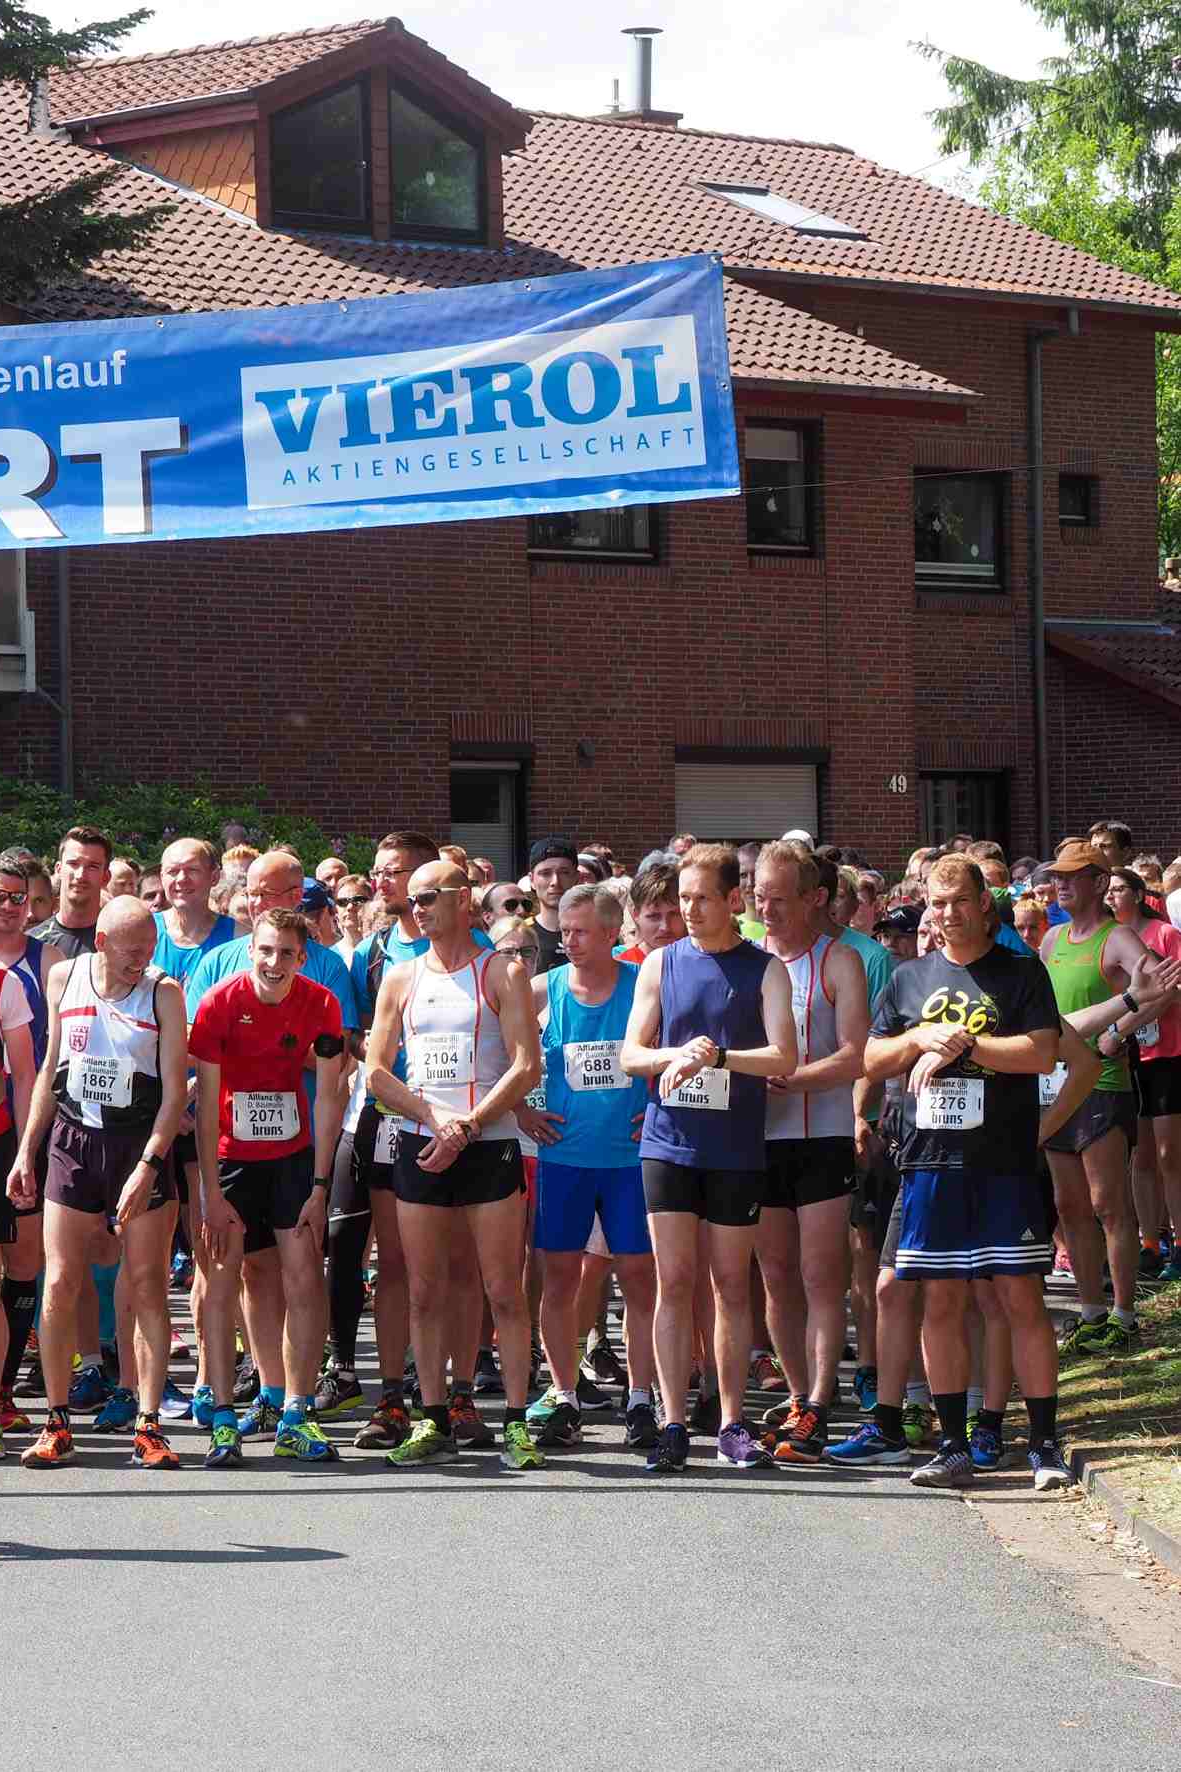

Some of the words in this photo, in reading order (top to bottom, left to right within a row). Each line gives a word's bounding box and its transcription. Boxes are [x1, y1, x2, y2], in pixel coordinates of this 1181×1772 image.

[255, 344, 693, 454] VIEROL
[282, 427, 695, 486] AKTIENGESELLSCHAFT
[889, 774, 908, 793] 49
[424, 1051, 459, 1065] 2104
[584, 1058, 612, 1072] 688
[426, 1066, 457, 1080] bruns
[582, 1073, 615, 1086] bruns
[82, 1073, 116, 1089] 1867
[82, 1086, 113, 1102] bruns
[247, 1093, 273, 1101] Allianz
[678, 1089, 710, 1104] bruns
[930, 1096, 967, 1110] 2276
[249, 1109, 284, 1122] 2071
[931, 1110, 964, 1125] bruns
[252, 1123, 284, 1137] bruns
